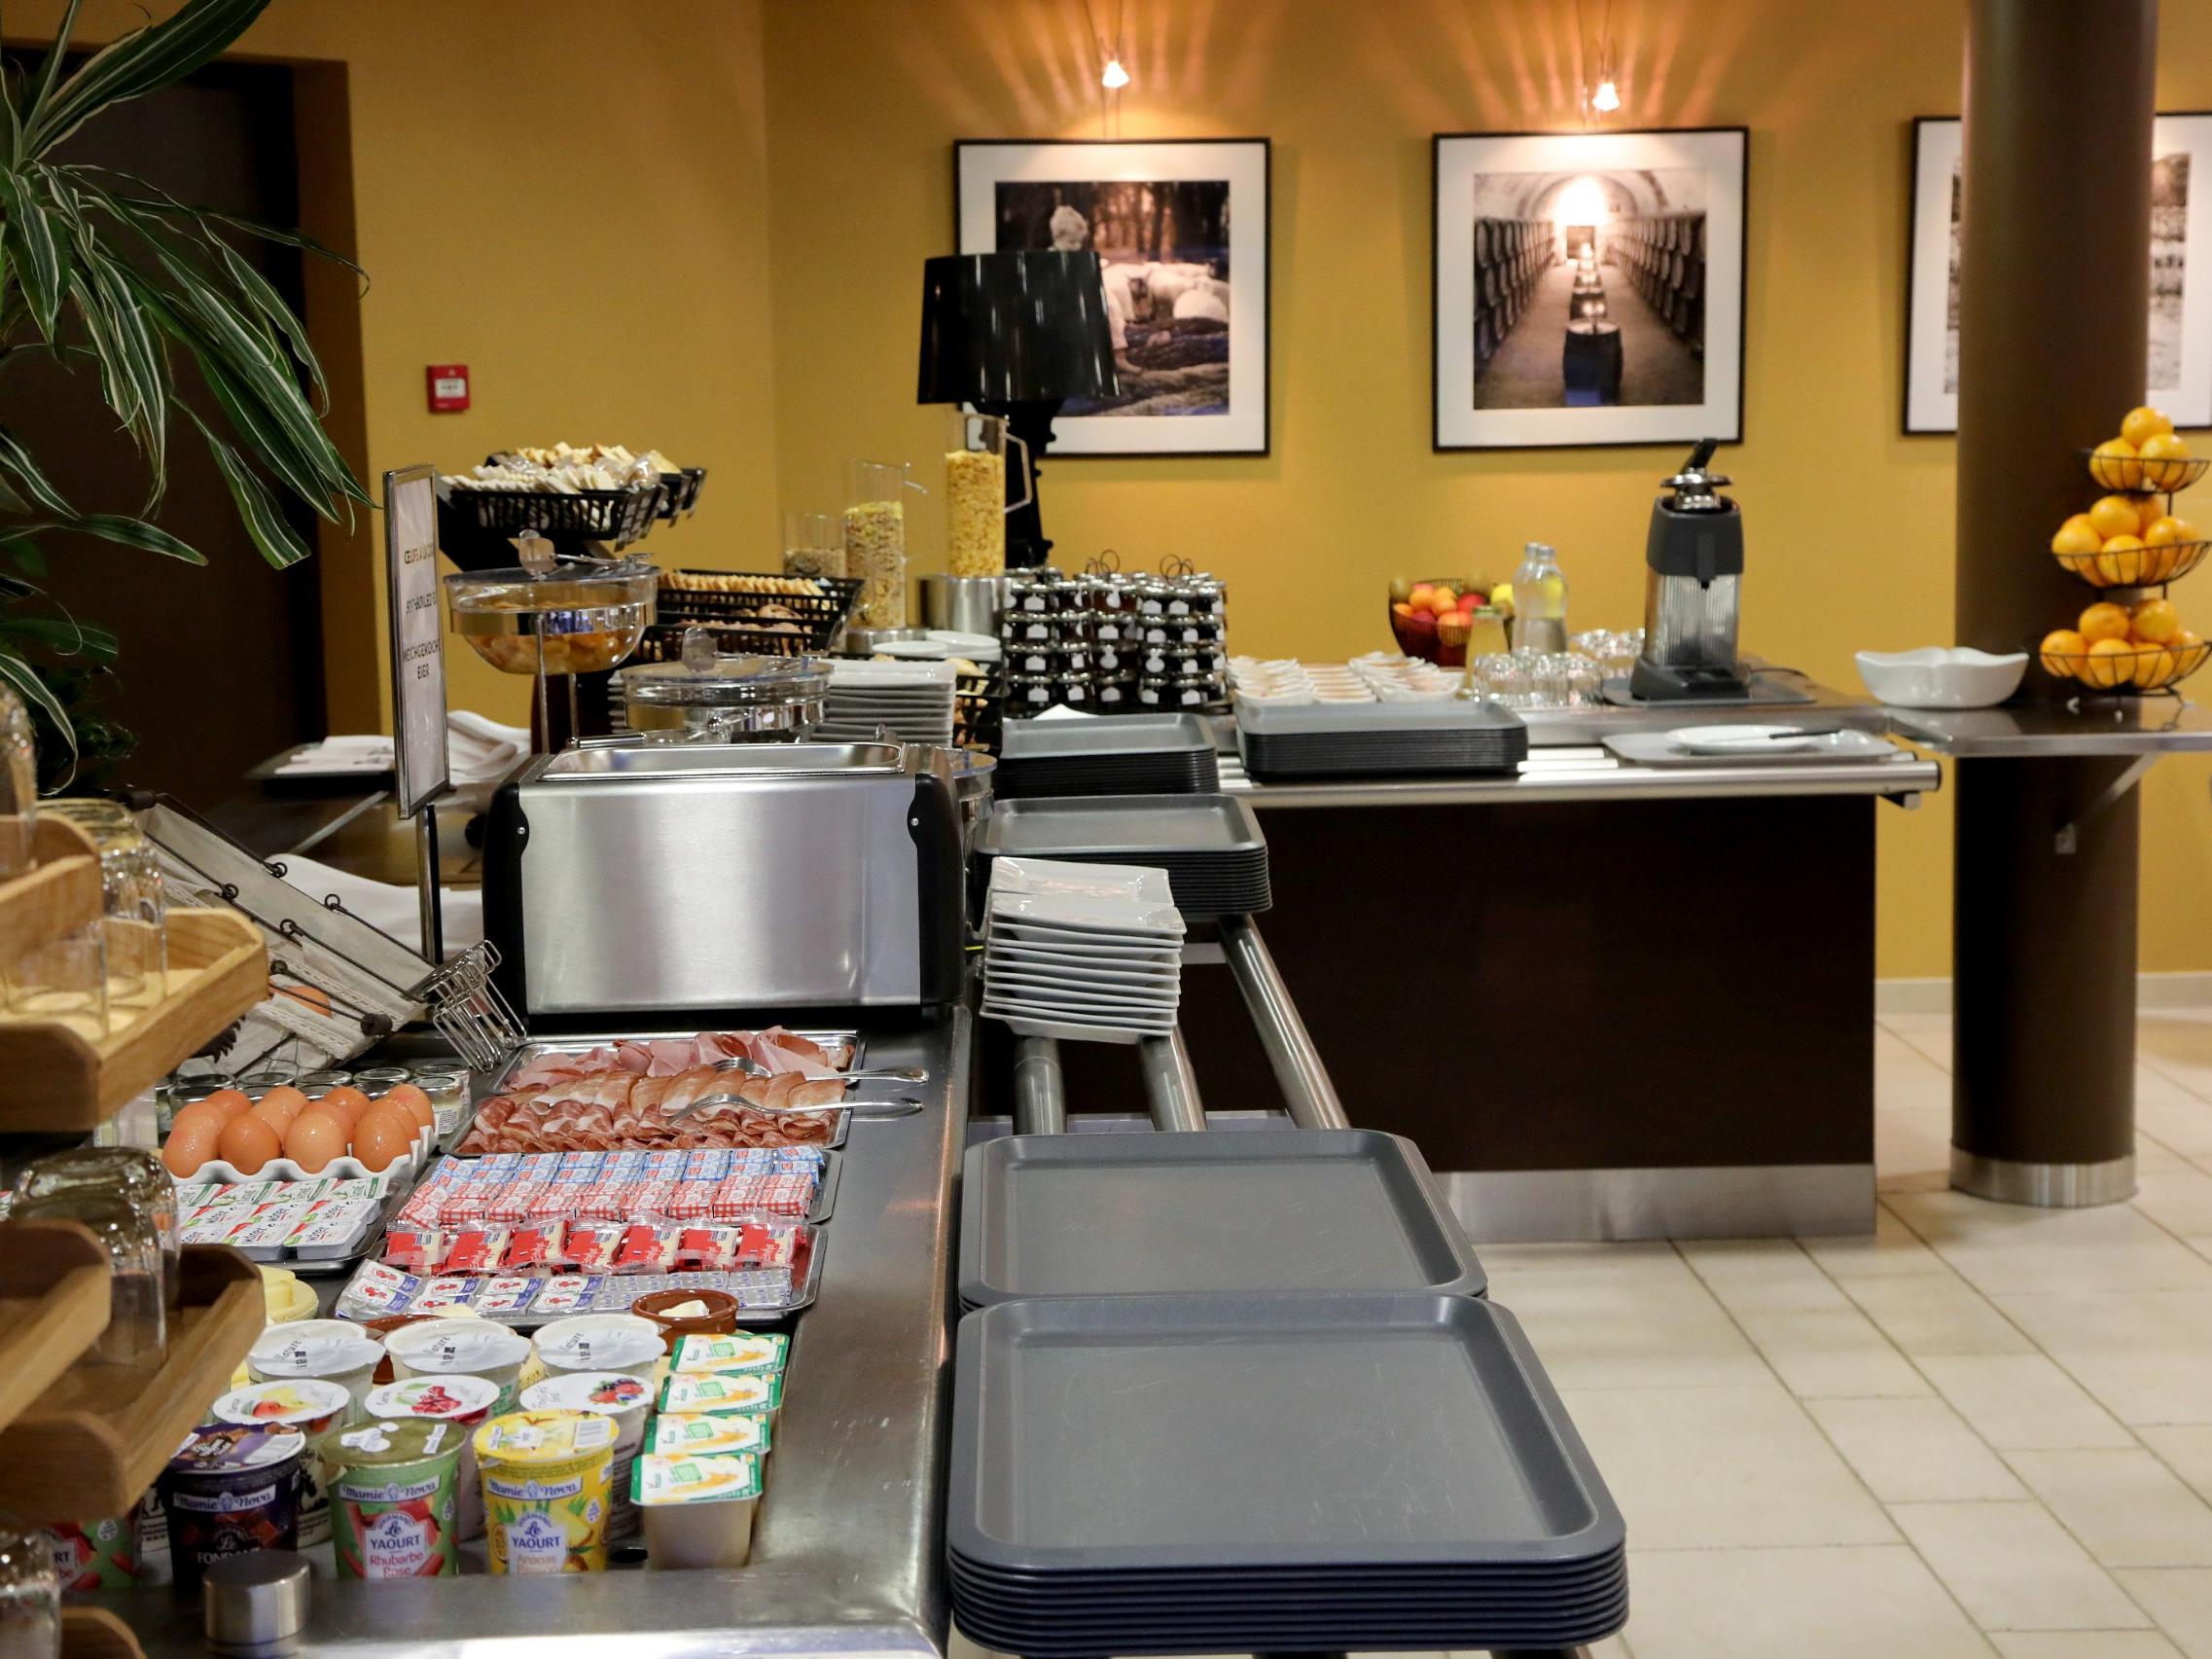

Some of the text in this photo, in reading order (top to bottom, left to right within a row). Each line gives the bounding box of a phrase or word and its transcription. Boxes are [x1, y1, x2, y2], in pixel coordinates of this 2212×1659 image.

[273, 1339, 303, 1361] Nature
[560, 1332, 584, 1352] Nature
[342, 1482, 436, 1499] Mamie Nova
[488, 1479, 577, 1496] Mamie Nova
[235, 1493, 270, 1508] Nova
[384, 1521, 401, 1537] Le
[524, 1521, 541, 1537] Le
[371, 1533, 420, 1550] YAOURT
[512, 1535, 560, 1549] YAOURT
[371, 1552, 423, 1567] Rhubarbe
